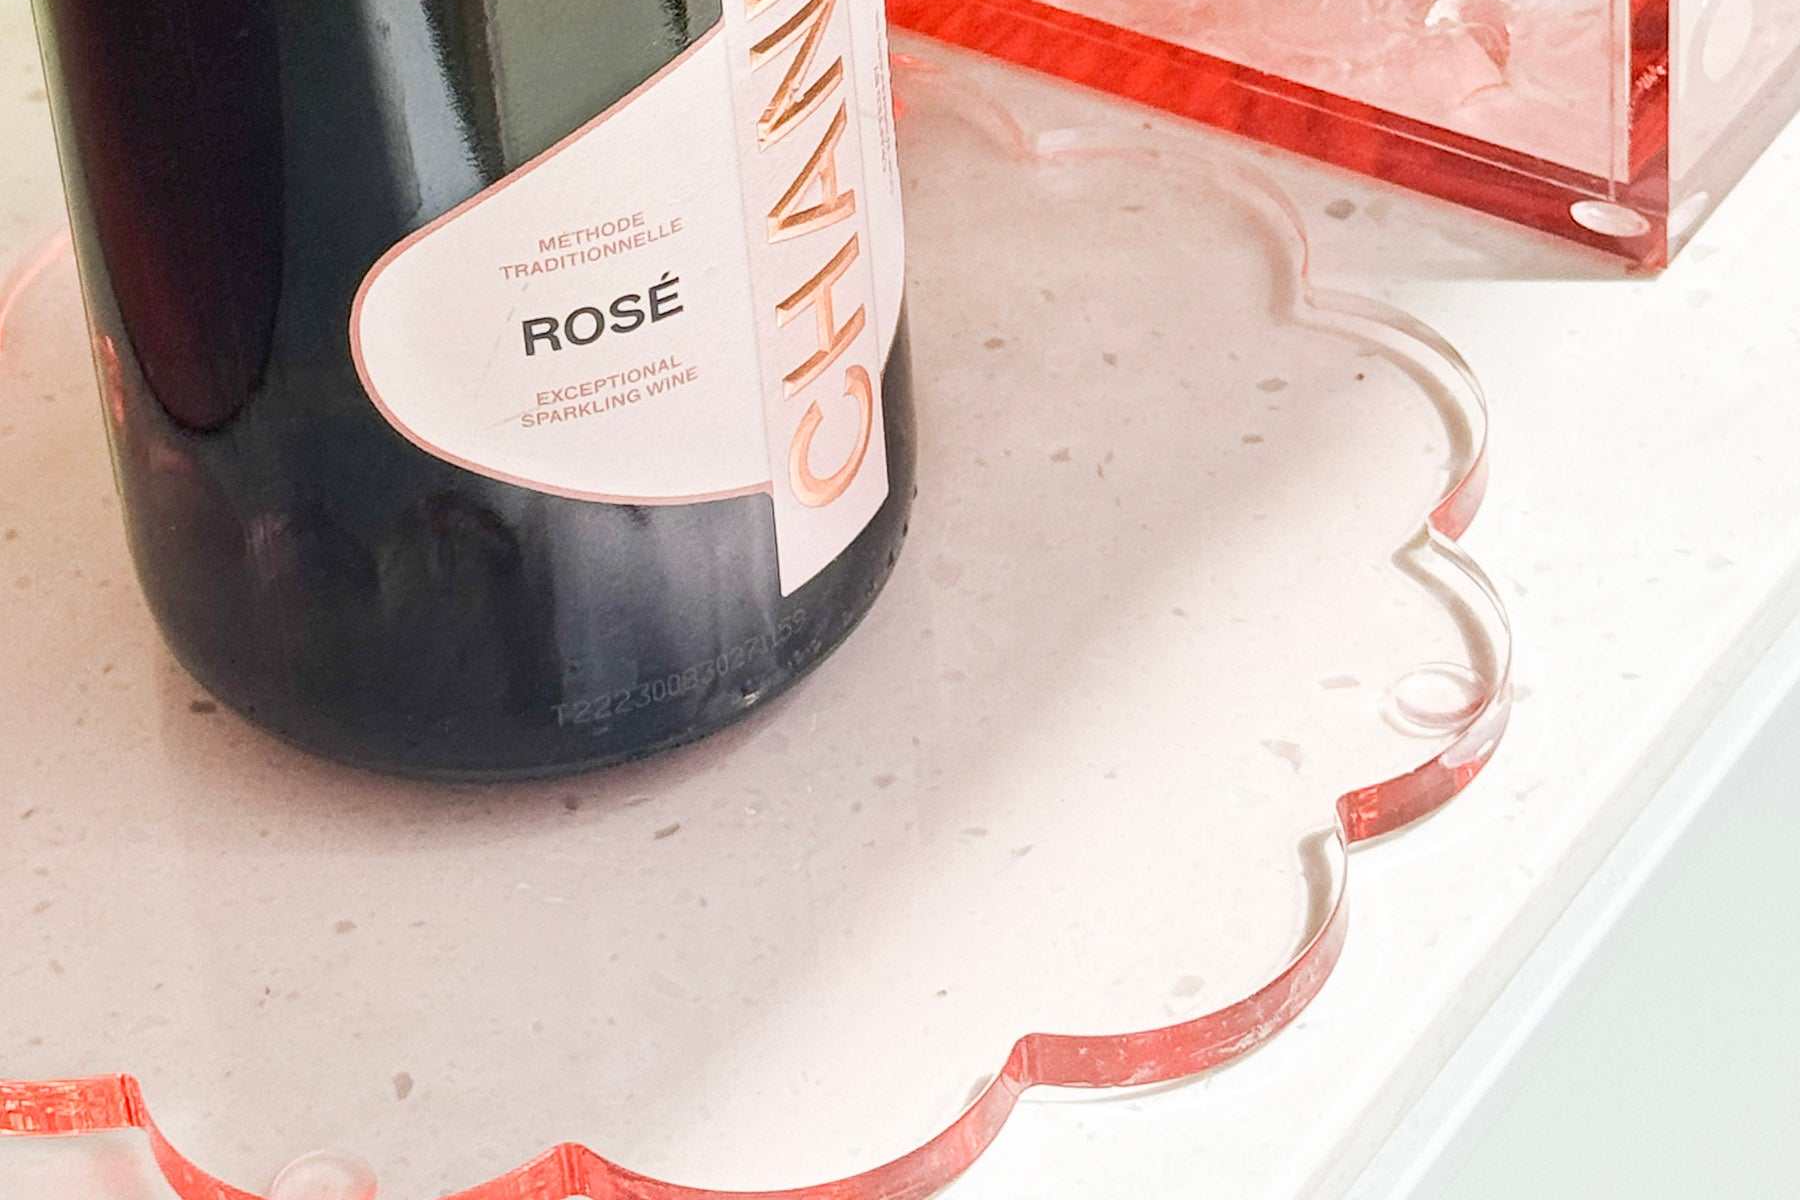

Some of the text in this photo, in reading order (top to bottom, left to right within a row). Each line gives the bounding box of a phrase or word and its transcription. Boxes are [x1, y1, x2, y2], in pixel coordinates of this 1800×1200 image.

[499, 217, 684, 280] TRADITIONNELLE
[522, 271, 684, 356] ROSÉ
[521, 365, 699, 429] SPARKLING WINE
[535, 355, 682, 408] EXCEPTIONAL
